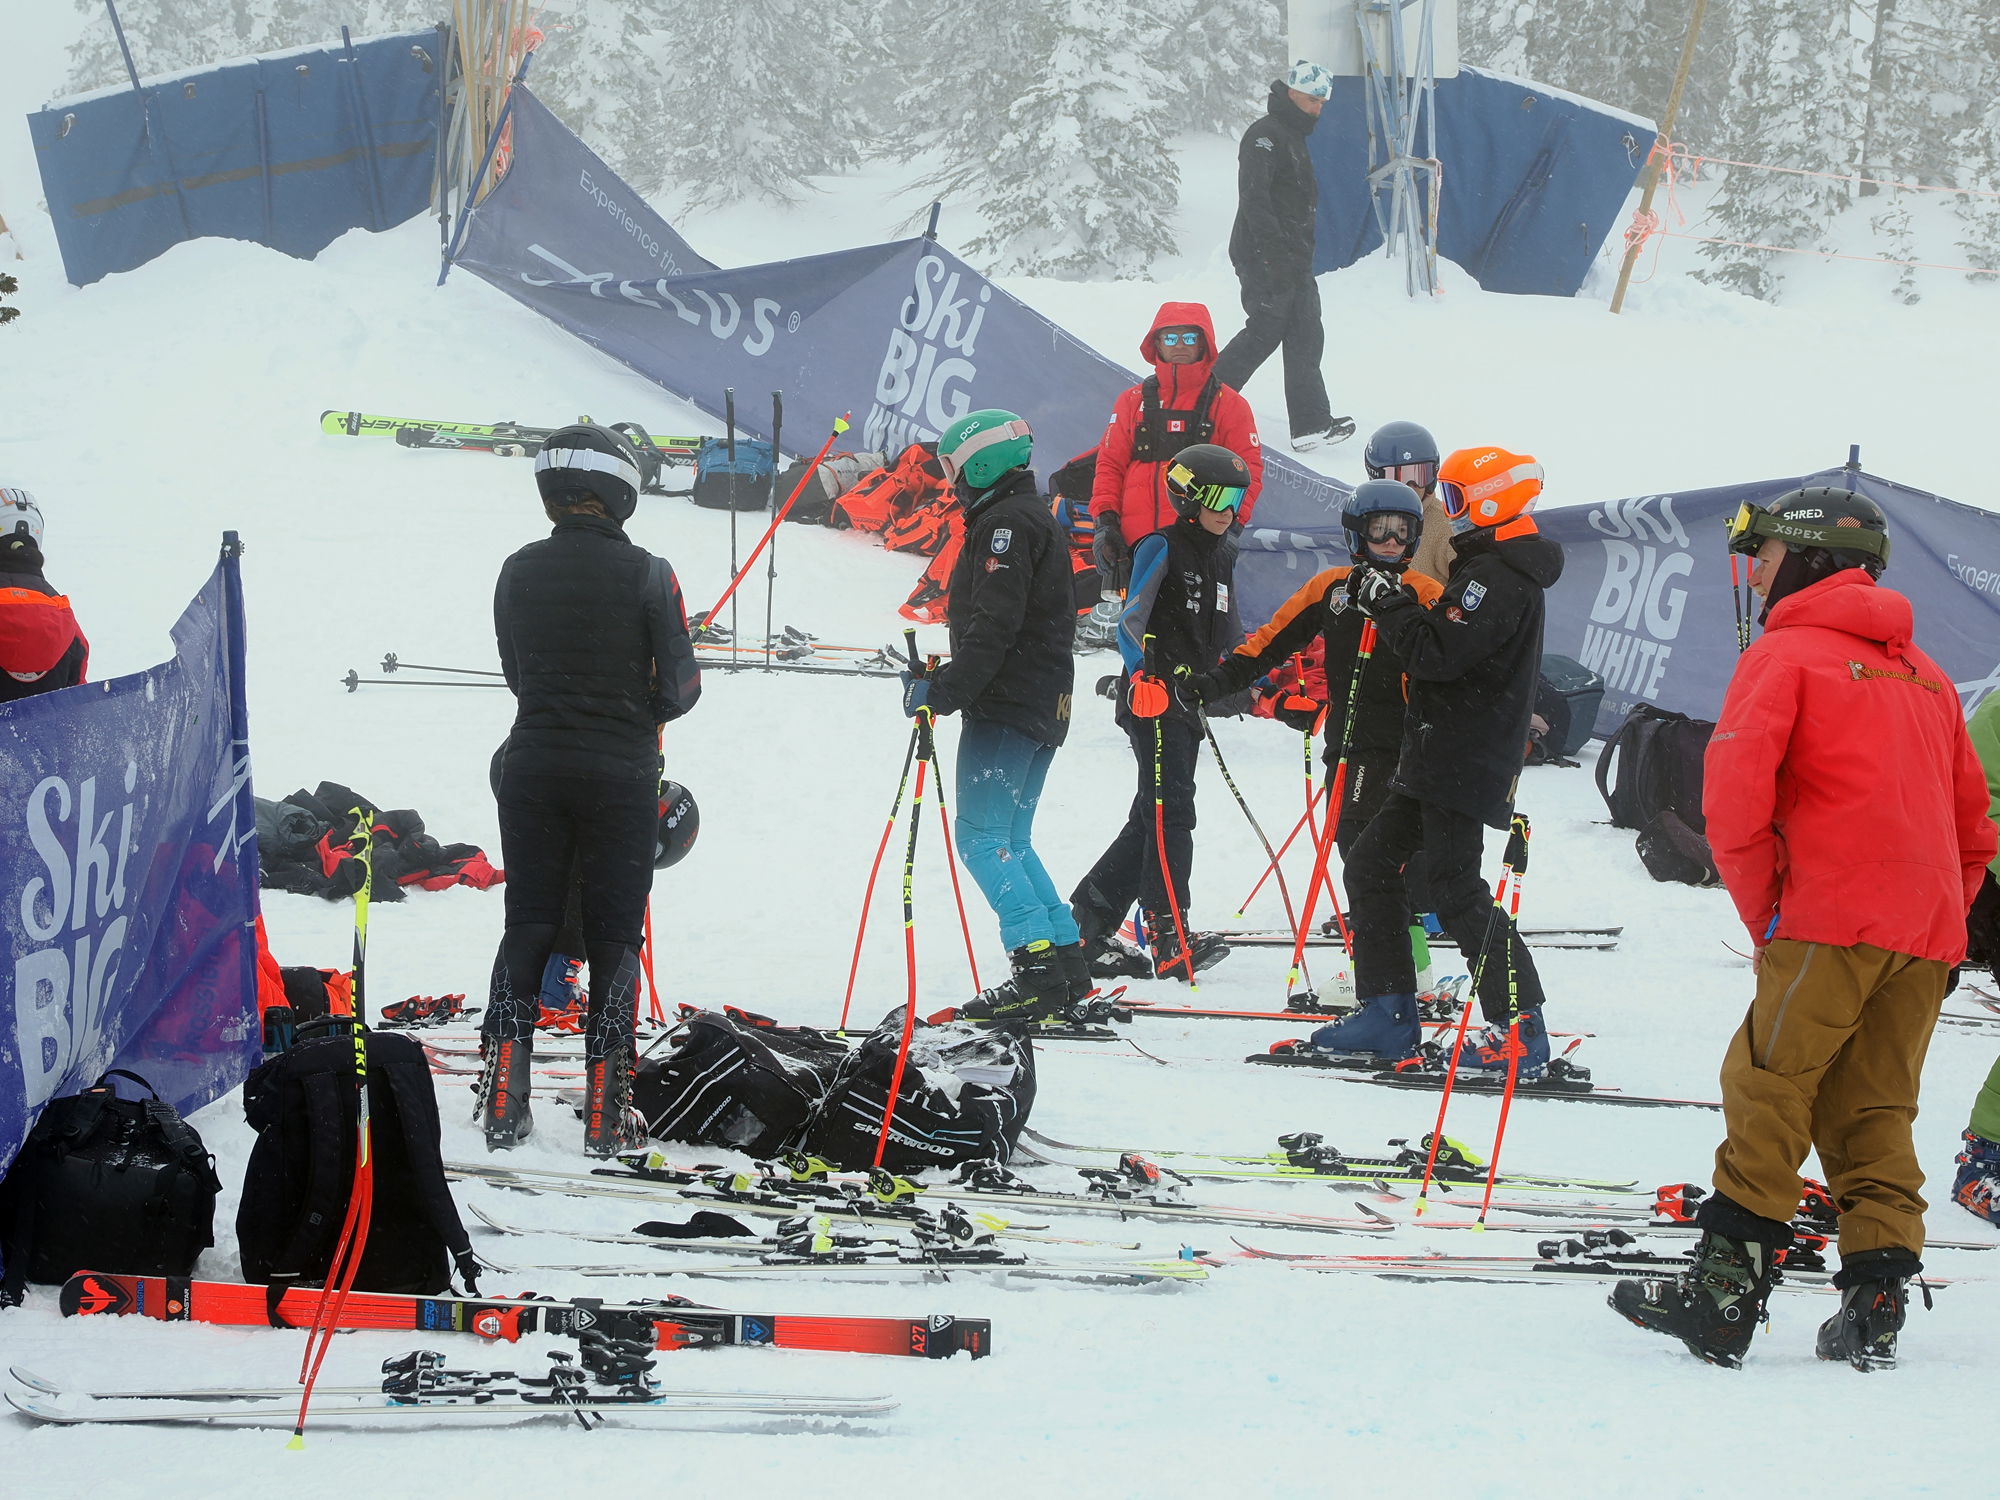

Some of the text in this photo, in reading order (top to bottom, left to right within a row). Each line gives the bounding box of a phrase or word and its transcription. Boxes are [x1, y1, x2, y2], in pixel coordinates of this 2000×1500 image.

[579, 169, 683, 276] Experience the
[901, 255, 992, 357] Ski
[875, 328, 978, 436] BIG
[862, 402, 941, 464] WHIT
[1774, 523, 1827, 541] XSPEX
[1590, 539, 1694, 640] BIG
[1579, 624, 1672, 700] WHITE
[905, 682, 915, 708] SHRED
[1352, 765, 1366, 802] KARBON
[20, 760, 138, 942] Ski
[903, 861, 913, 904] LEKI
[993, 996, 1038, 1015] FISCHER
[1508, 969, 1518, 1011] LEKI
[353, 1023, 366, 1076] LEKI
[136, 1280, 145, 1314] SSIGNOL
[424, 1300, 434, 1330] HERO
[911, 1325, 926, 1353] A27
